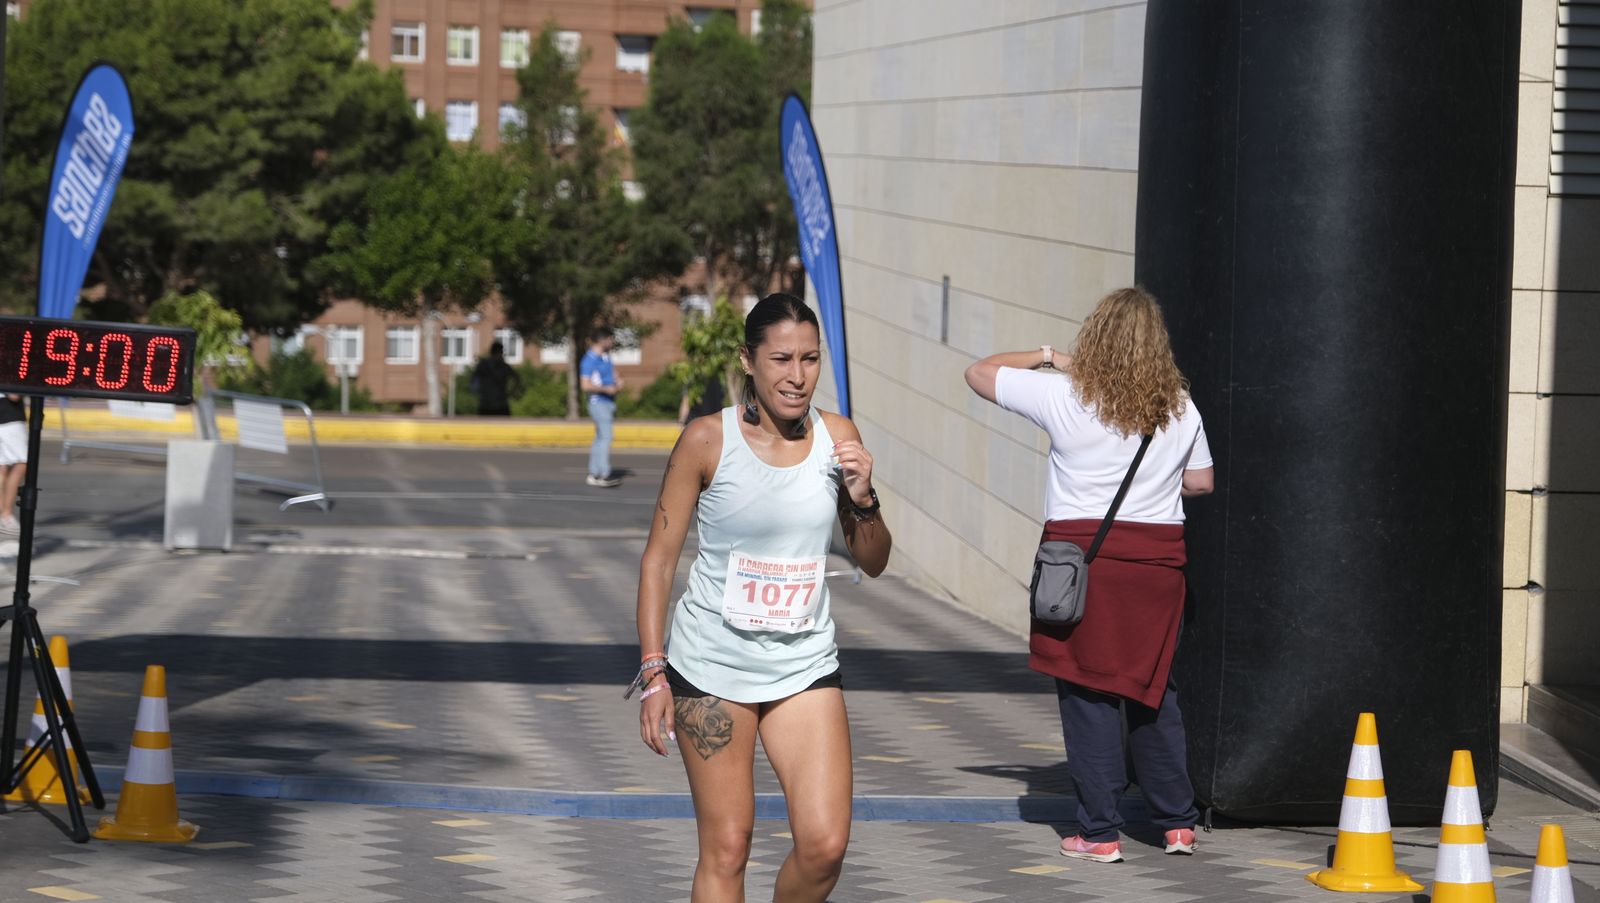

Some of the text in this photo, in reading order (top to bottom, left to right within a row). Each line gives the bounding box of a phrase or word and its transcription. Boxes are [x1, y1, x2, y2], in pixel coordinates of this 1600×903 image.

[18, 328, 180, 393] 19:00
[747, 559, 783, 572] CARRERA
[786, 563, 799, 573] SIN
[800, 562, 818, 572] HUMO
[742, 580, 816, 606] 1077
